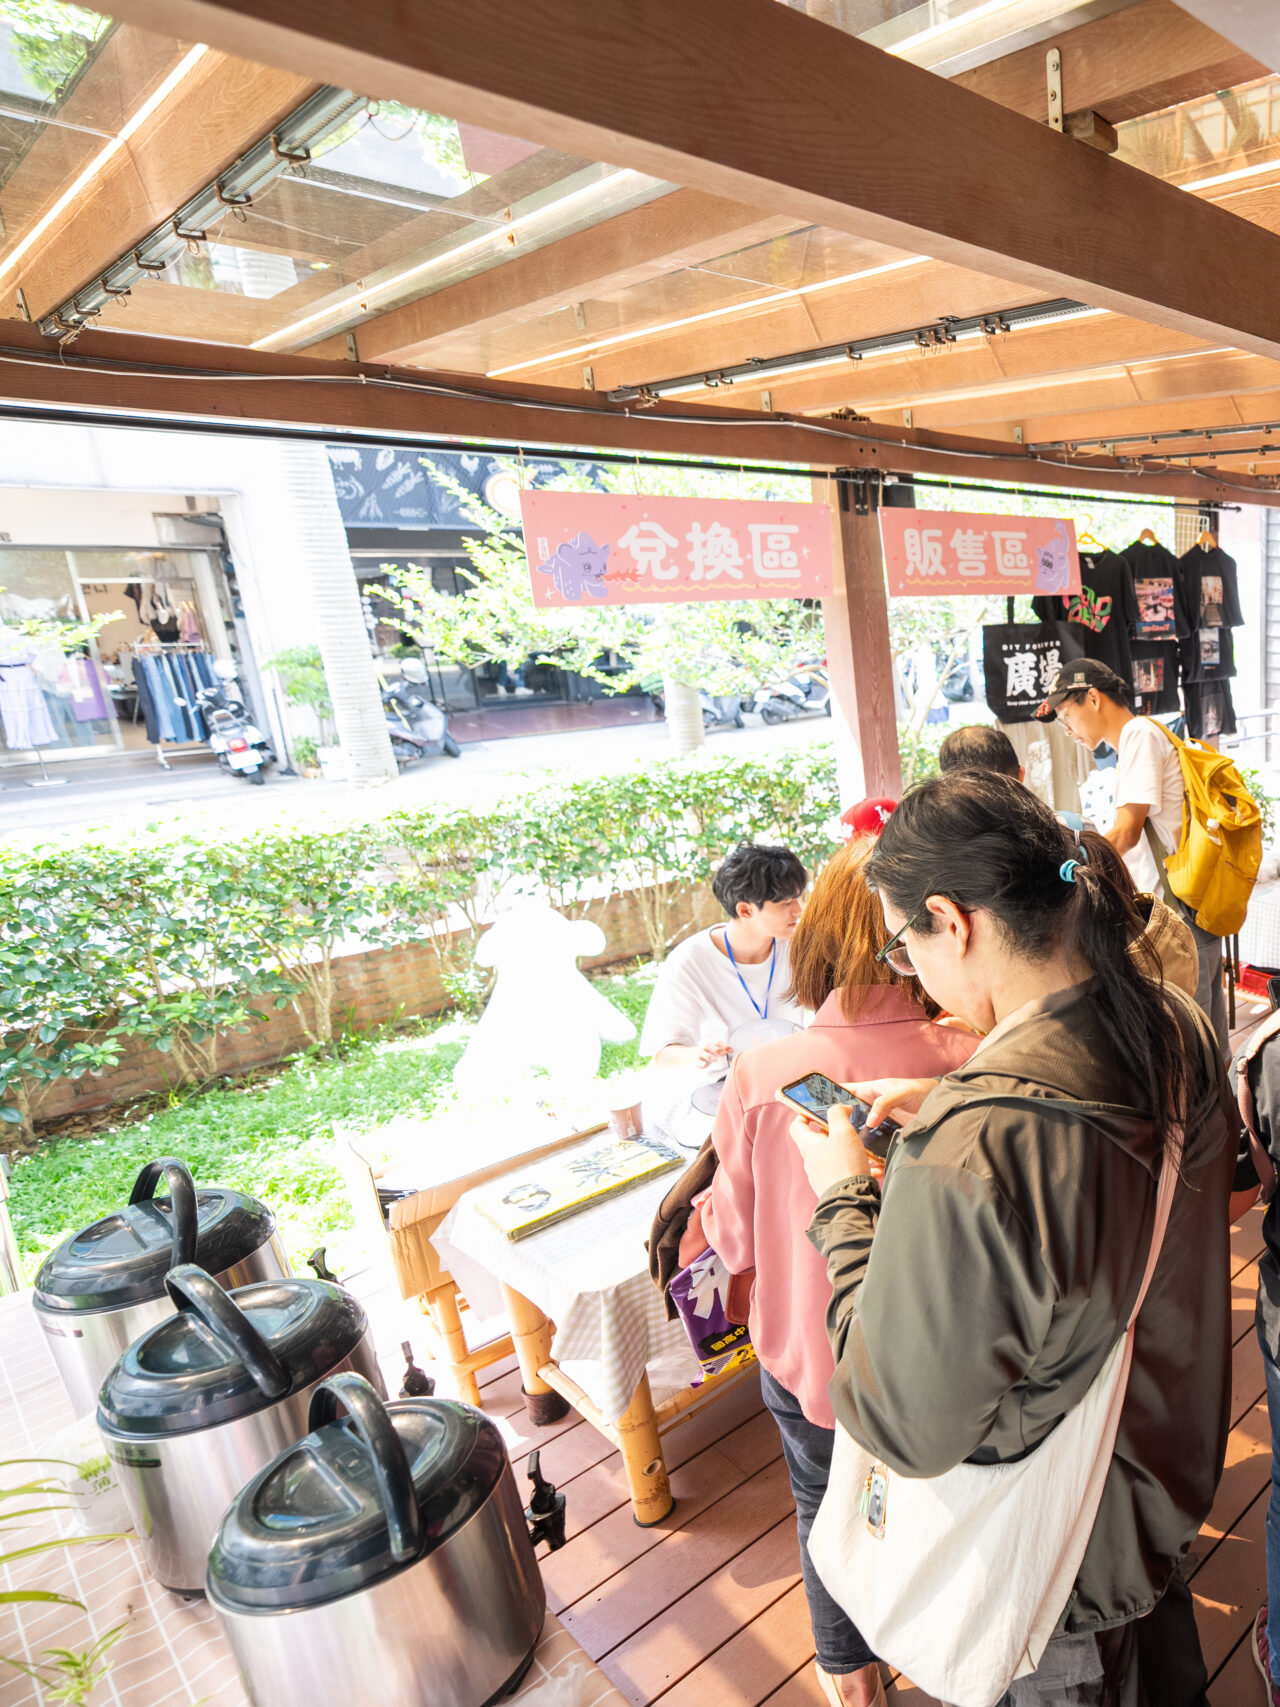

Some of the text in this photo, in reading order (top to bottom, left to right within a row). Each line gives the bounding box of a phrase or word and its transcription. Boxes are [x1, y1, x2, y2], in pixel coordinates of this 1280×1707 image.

[617, 521, 801, 581] 兌換區
[904, 528, 1032, 578] 販售區
[1002, 643, 1020, 651] DIY
[1003, 649, 1063, 697] 廣場
[711, 1325, 749, 1352] 國高中
